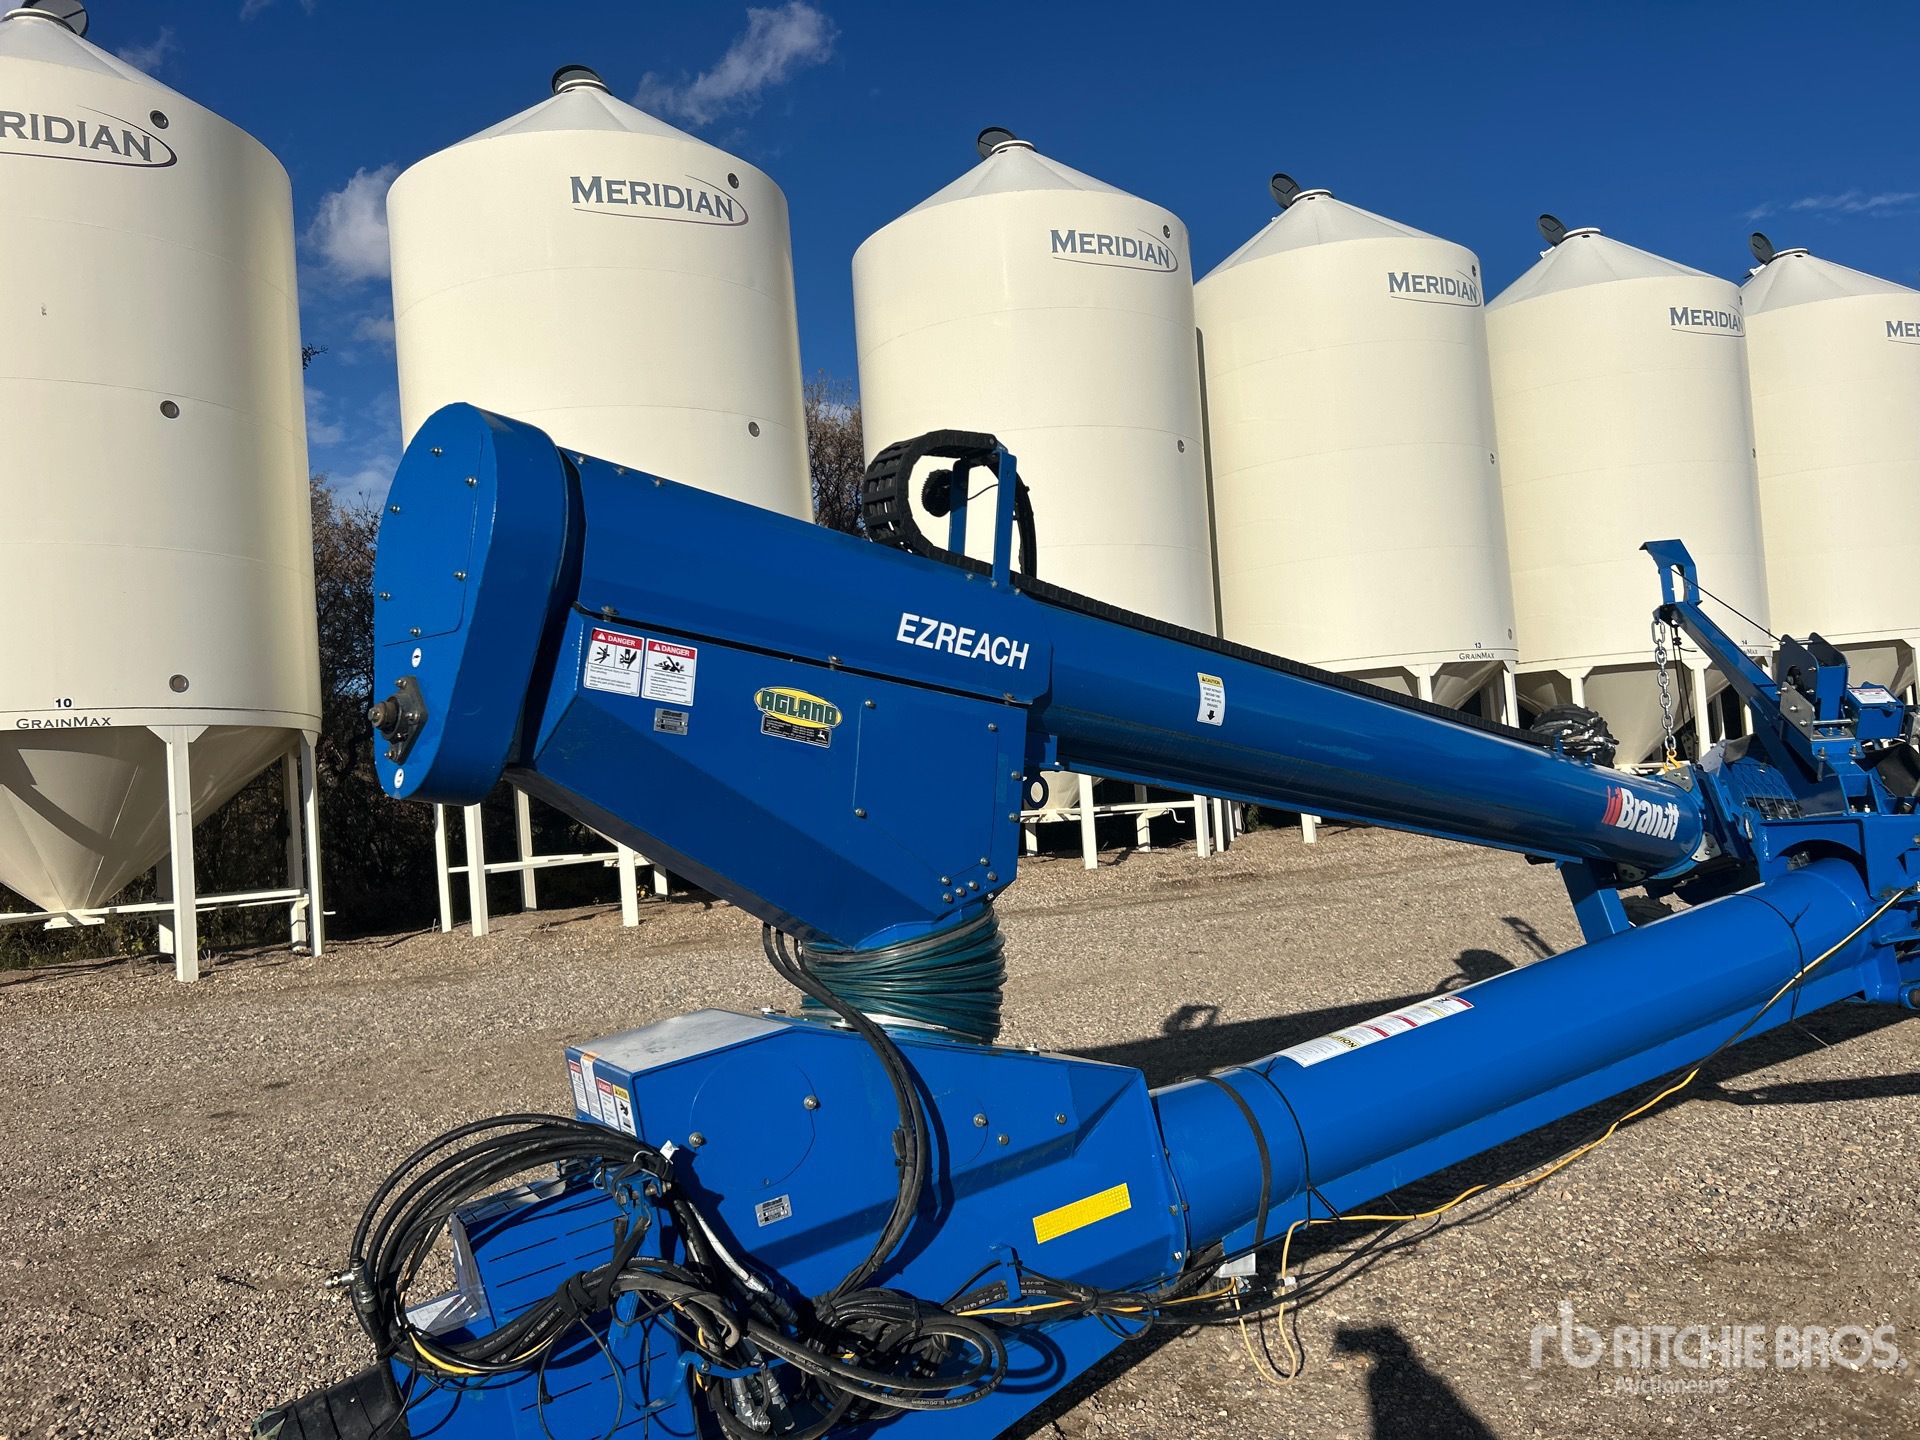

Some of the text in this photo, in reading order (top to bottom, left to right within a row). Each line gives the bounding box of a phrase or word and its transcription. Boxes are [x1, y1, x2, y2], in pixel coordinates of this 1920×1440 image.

[570, 176, 734, 222] MERIDIAN
[1050, 229, 1170, 269] MERIDIAN
[1387, 272, 1478, 304] MERIDIAN
[608, 635, 636, 646] DANGER
[661, 645, 690, 657] DANGER
[896, 612, 1029, 670] EZREACH
[55, 698, 72, 708] 10
[760, 690, 837, 726] AGLAND
[1615, 787, 1680, 840] Brandt
